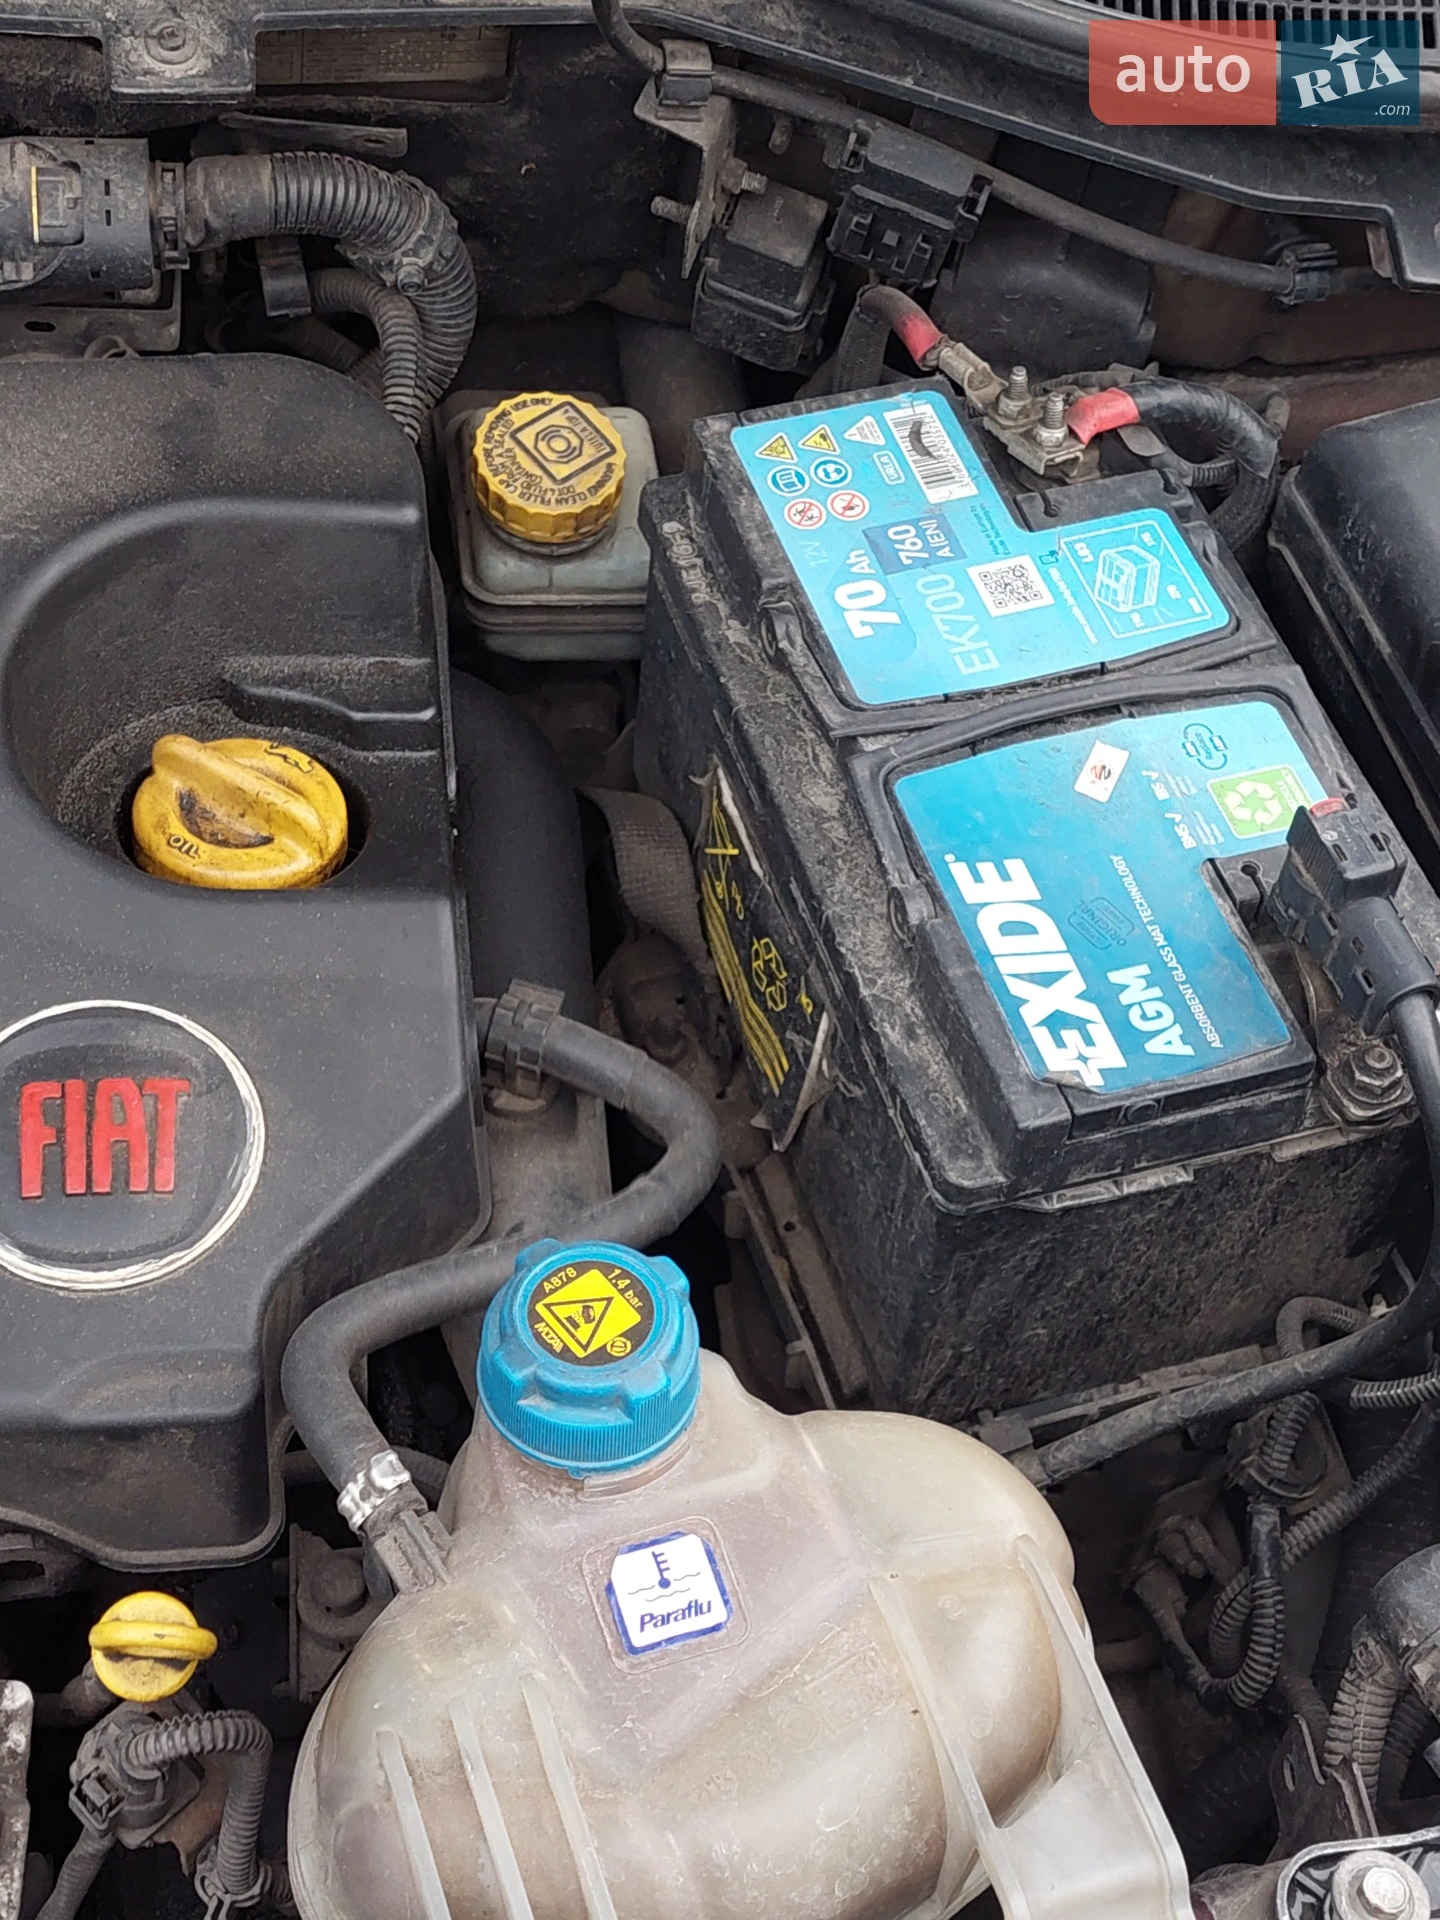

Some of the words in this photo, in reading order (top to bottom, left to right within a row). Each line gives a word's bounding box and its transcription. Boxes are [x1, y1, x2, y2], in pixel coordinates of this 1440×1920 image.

[483, 408, 512, 445] REMOVING
[492, 418, 515, 450] SEALED
[580, 426, 607, 453] TUTELA
[482, 447, 504, 478] BEFORE
[499, 459, 521, 484] FROM
[505, 447, 543, 485] CONTAINER
[498, 478, 518, 495] CAP
[519, 490, 551, 507] FILLER
[555, 489, 587, 506] CLEAN
[557, 484, 576, 497] DOT
[804, 540, 829, 567] 12V
[887, 524, 930, 565] 760
[845, 549, 876, 574] Ah
[834, 579, 902, 639] 70
[916, 574, 1001, 676] EK700
[168, 834, 201, 860] OIL
[1174, 823, 1198, 850] BMS
[1110, 854, 1154, 926] TECHNOLOGY
[1079, 899, 1127, 947] ORIGINAL
[1147, 925, 1167, 947] MAT
[948, 858, 1128, 1086] EXIDE
[1159, 946, 1186, 982] GLASS
[1106, 963, 1195, 1056] AGM
[1178, 983, 1223, 1048] ABSORBENT
[20, 1078, 191, 1200] FIAT
[542, 1267, 577, 1293] A878
[607, 1268, 632, 1291] 1.4
[623, 1289, 644, 1309] bar
[639, 1598, 712, 1633] Paraflu
